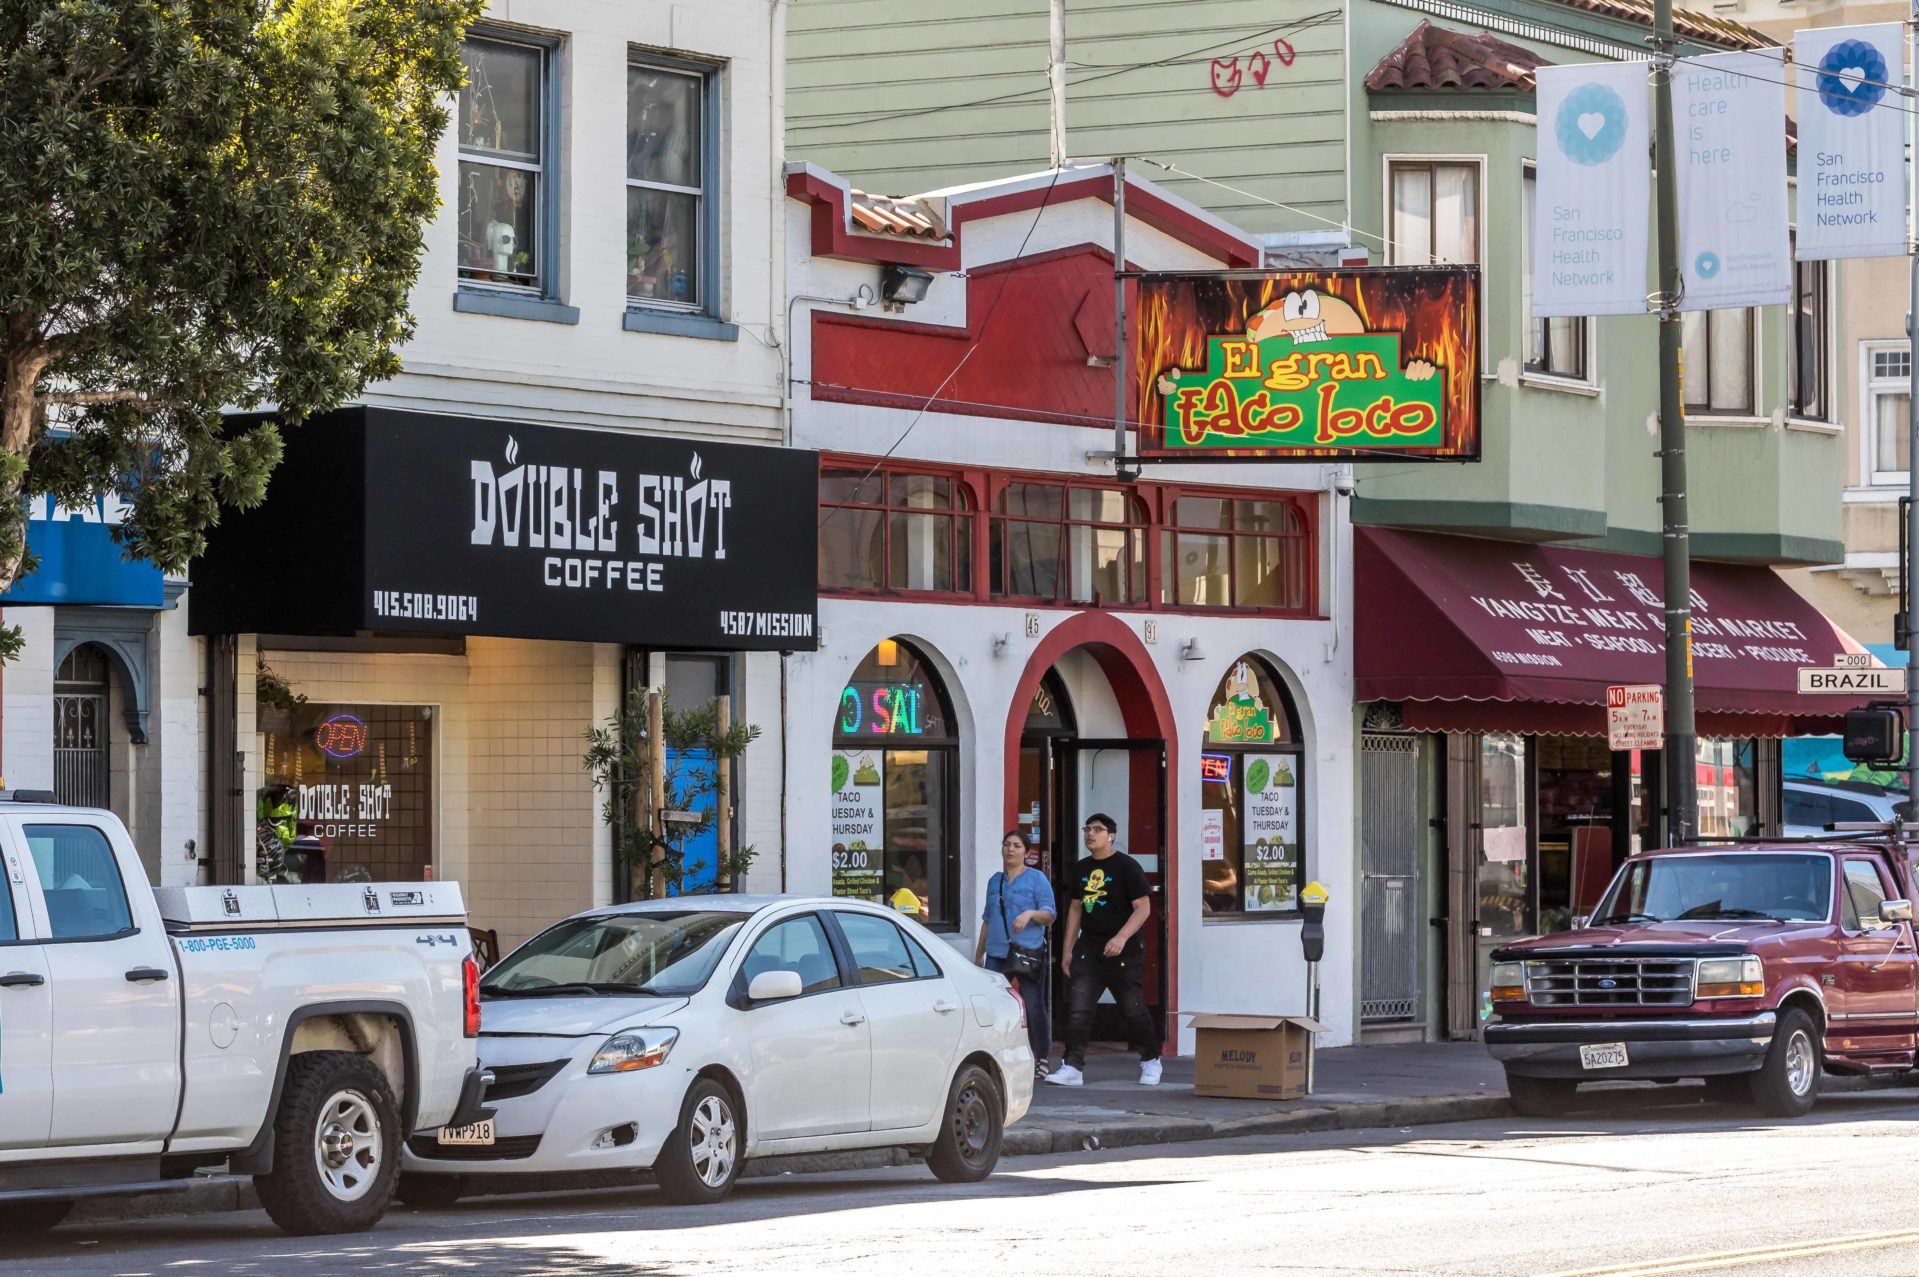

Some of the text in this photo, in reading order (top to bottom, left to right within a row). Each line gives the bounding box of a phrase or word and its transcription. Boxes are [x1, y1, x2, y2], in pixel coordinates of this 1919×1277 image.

[1688, 71, 1748, 93] Health
[1688, 100, 1727, 117] care
[1690, 124, 1703, 141] is
[1690, 148, 1730, 165] here
[1817, 152, 1843, 167] San
[1817, 171, 1884, 187] Francisco
[1817, 191, 1863, 207] Health
[1553, 206, 1580, 221] San
[1817, 209, 1878, 227] Network
[1553, 227, 1623, 242] Francisco
[1553, 248, 1600, 264] Health
[1552, 270, 1614, 286] Network
[1223, 342, 1387, 391] El gran
[1315, 382, 1437, 444] loco
[471, 460, 731, 559] DOUBLE SHOT
[545, 557, 664, 592] COFFEE
[374, 590, 477, 621] 415.508.9064
[721, 611, 812, 636] 4587 MISSION
[1028, 617, 1039, 633] 45
[1471, 596, 1588, 626] YANGTZE
[1581, 607, 1648, 630] MEAT
[1647, 612, 1666, 632] &
[1717, 618, 1807, 640] MARKET
[1147, 624, 1157, 640] 91
[1525, 628, 1816, 664] MEAT SEAFOOD OCERY PRODUCE
[1514, 653, 1562, 666] MISSION
[1847, 656, 1867, 665] 000
[1810, 674, 1889, 688] BRAZIL
[1609, 688, 1660, 705] NO PARKING
[316, 723, 368, 751] OPEN
[1201, 759, 1227, 777] PEN
[299, 784, 392, 819] DOUBLE SHOT
[838, 792, 860, 802] TACO
[1261, 792, 1279, 801] TACO
[832, 808, 874, 818] UESDAY &
[1252, 807, 1289, 816] TUESDAY &
[314, 824, 376, 837] COFFEE
[832, 824, 873, 835] HURSDAY
[1253, 821, 1289, 830] THURSDAY
[832, 852, 867, 869] $2.00
[1257, 845, 1285, 860] $2.00
[179, 937, 256, 952] 1-800-PGE-5000
[1221, 1050, 1257, 1063] MELODY
[1584, 1051, 1625, 1067] 5A20275
